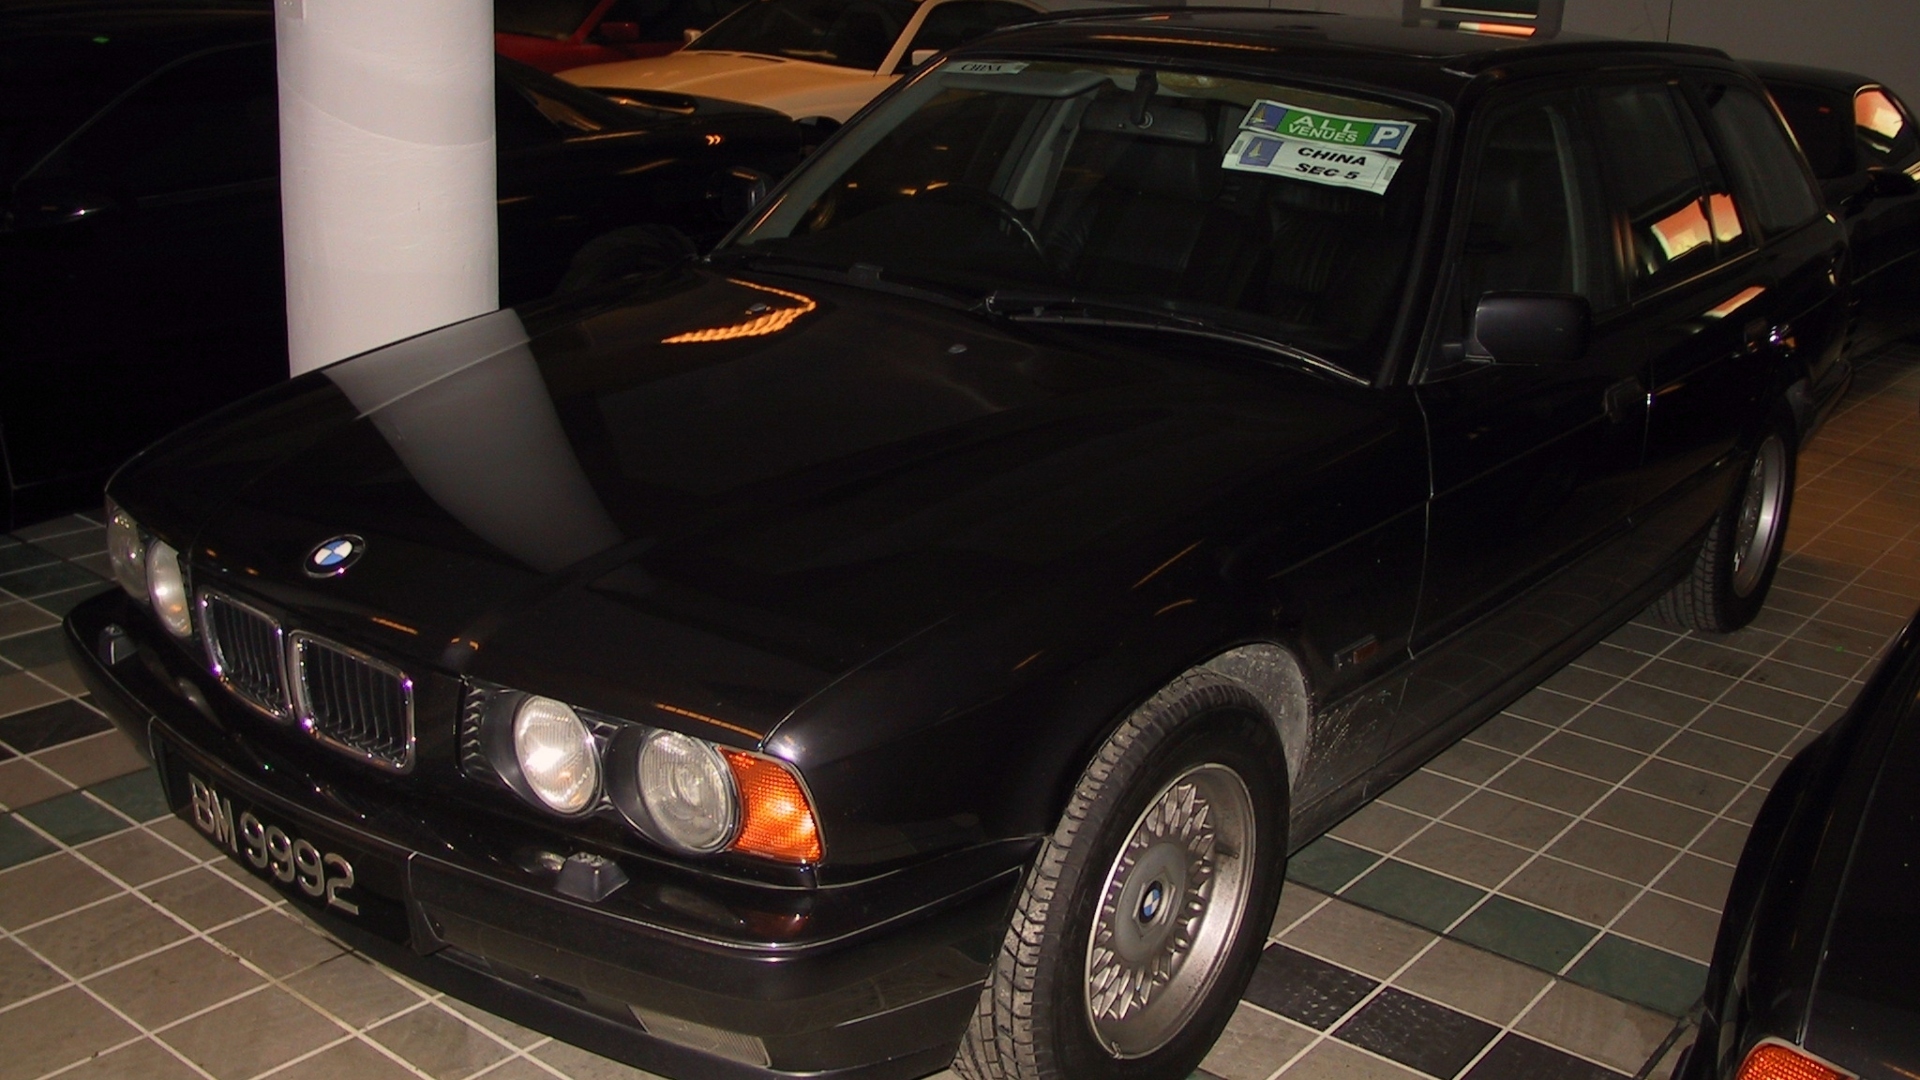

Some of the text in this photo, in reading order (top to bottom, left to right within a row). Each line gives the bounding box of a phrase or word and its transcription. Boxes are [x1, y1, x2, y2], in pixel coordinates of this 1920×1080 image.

[1287, 123, 1358, 144] VENUES
[1293, 115, 1359, 134] ALL
[1371, 126, 1401, 145] P
[1298, 147, 1367, 166] CHINA
[1295, 163, 1360, 180] SEC 5
[188, 772, 359, 916] BM 9992
